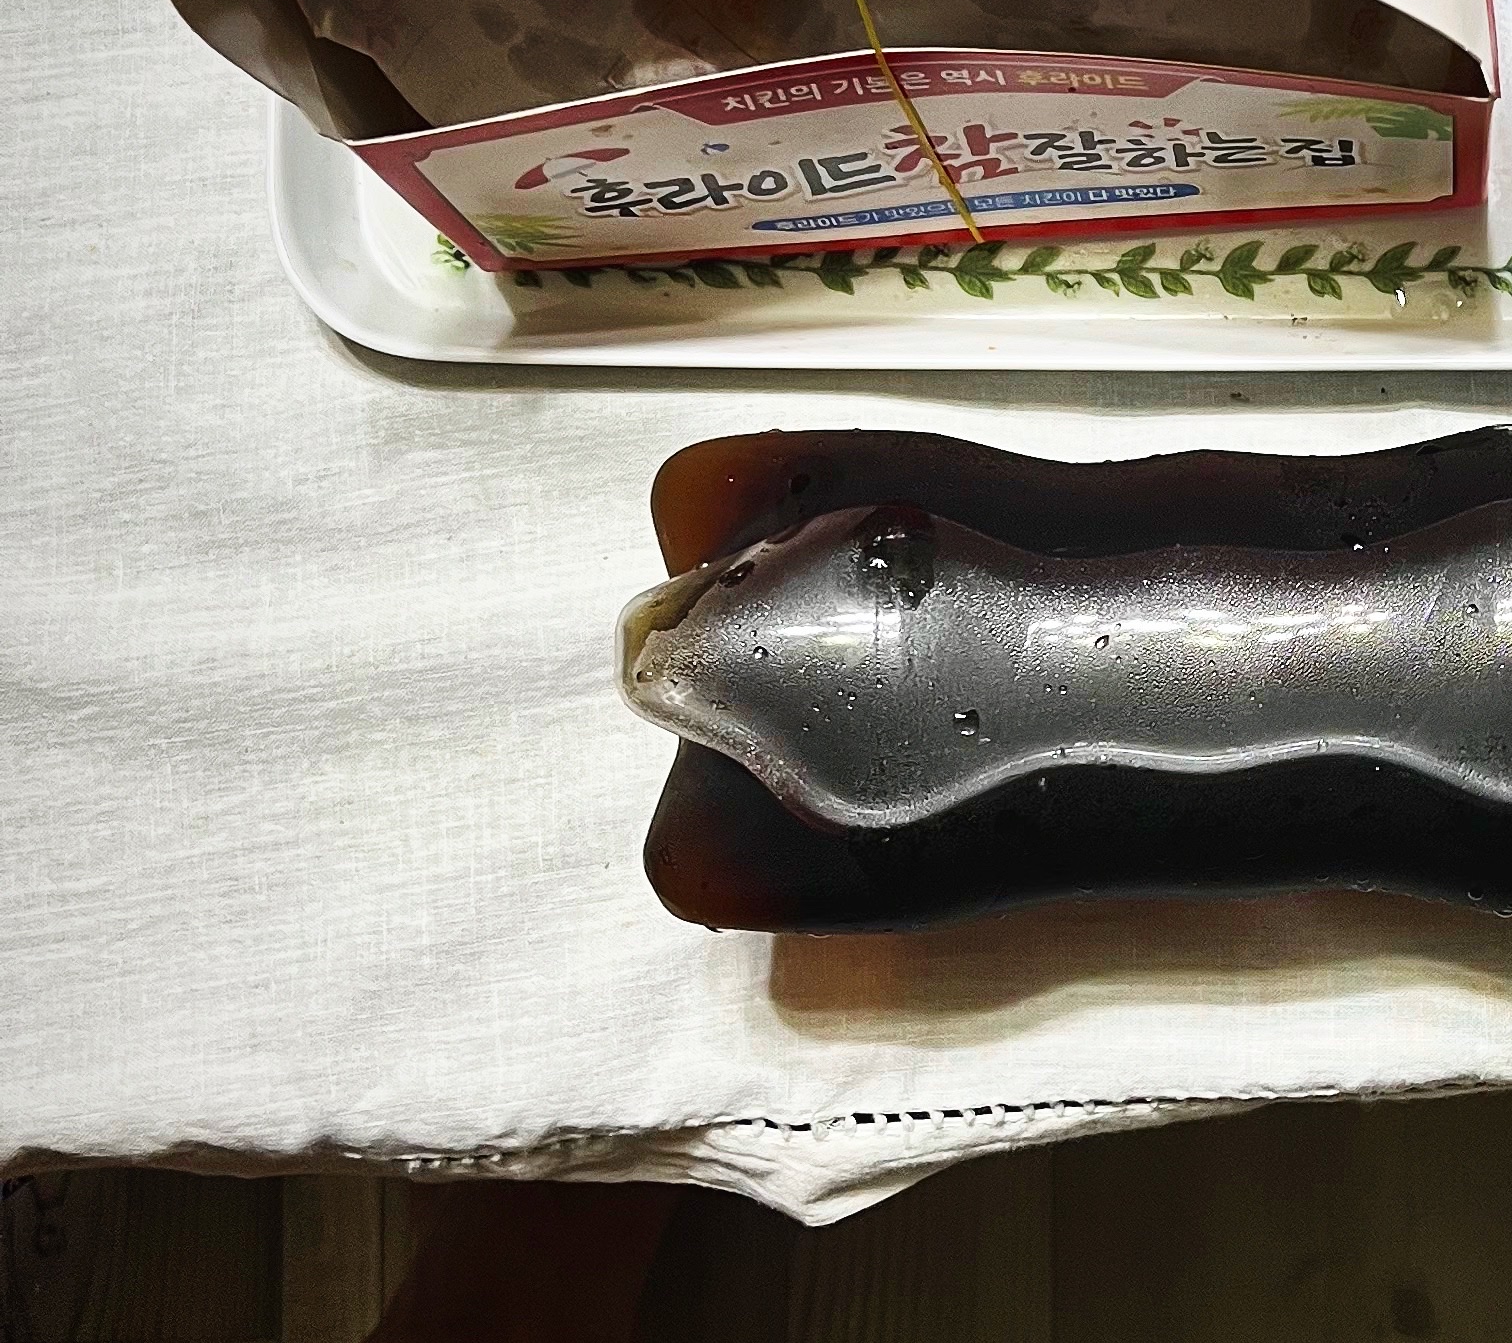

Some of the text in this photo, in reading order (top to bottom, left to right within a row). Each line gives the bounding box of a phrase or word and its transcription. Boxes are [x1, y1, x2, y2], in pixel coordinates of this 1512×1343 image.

[721, 82, 824, 114] 치킨의
[940, 68, 1008, 88] 역시
[1018, 70, 1150, 91] 후라이드
[1088, 188, 1111, 202] 다
